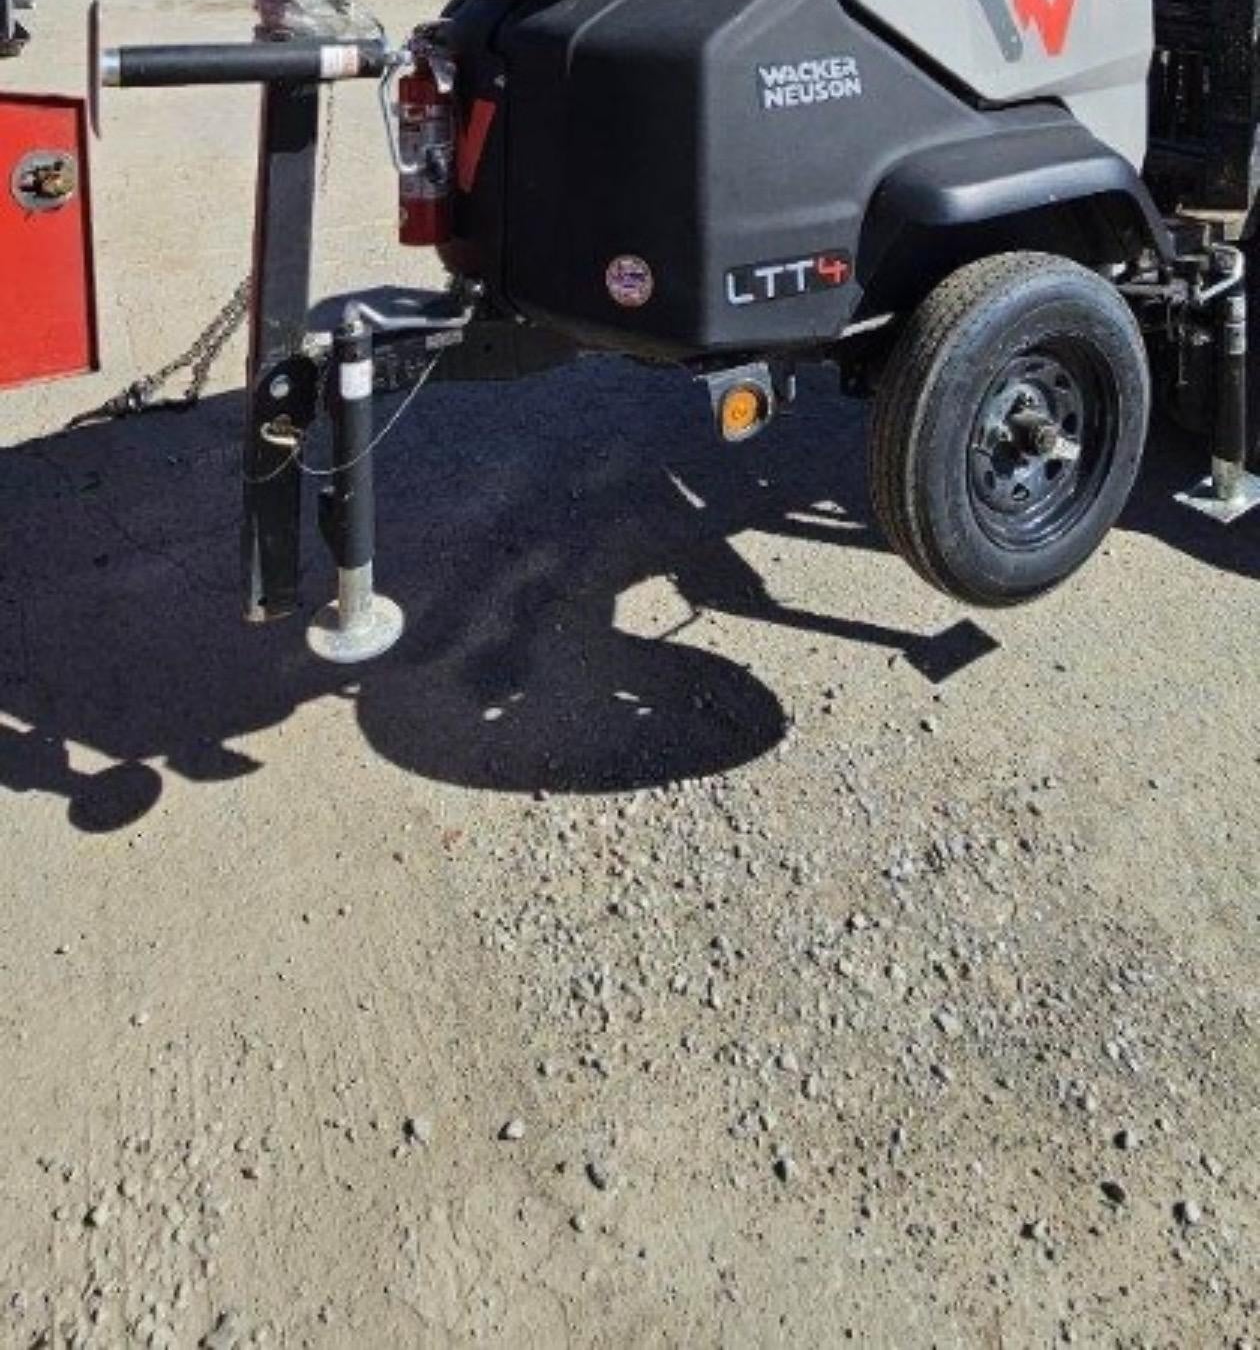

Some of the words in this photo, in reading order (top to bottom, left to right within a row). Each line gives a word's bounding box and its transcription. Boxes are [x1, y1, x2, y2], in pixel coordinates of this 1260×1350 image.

[759, 56, 859, 88] WACKER
[763, 77, 862, 109] NEUSON
[726, 256, 848, 304] LTT4
